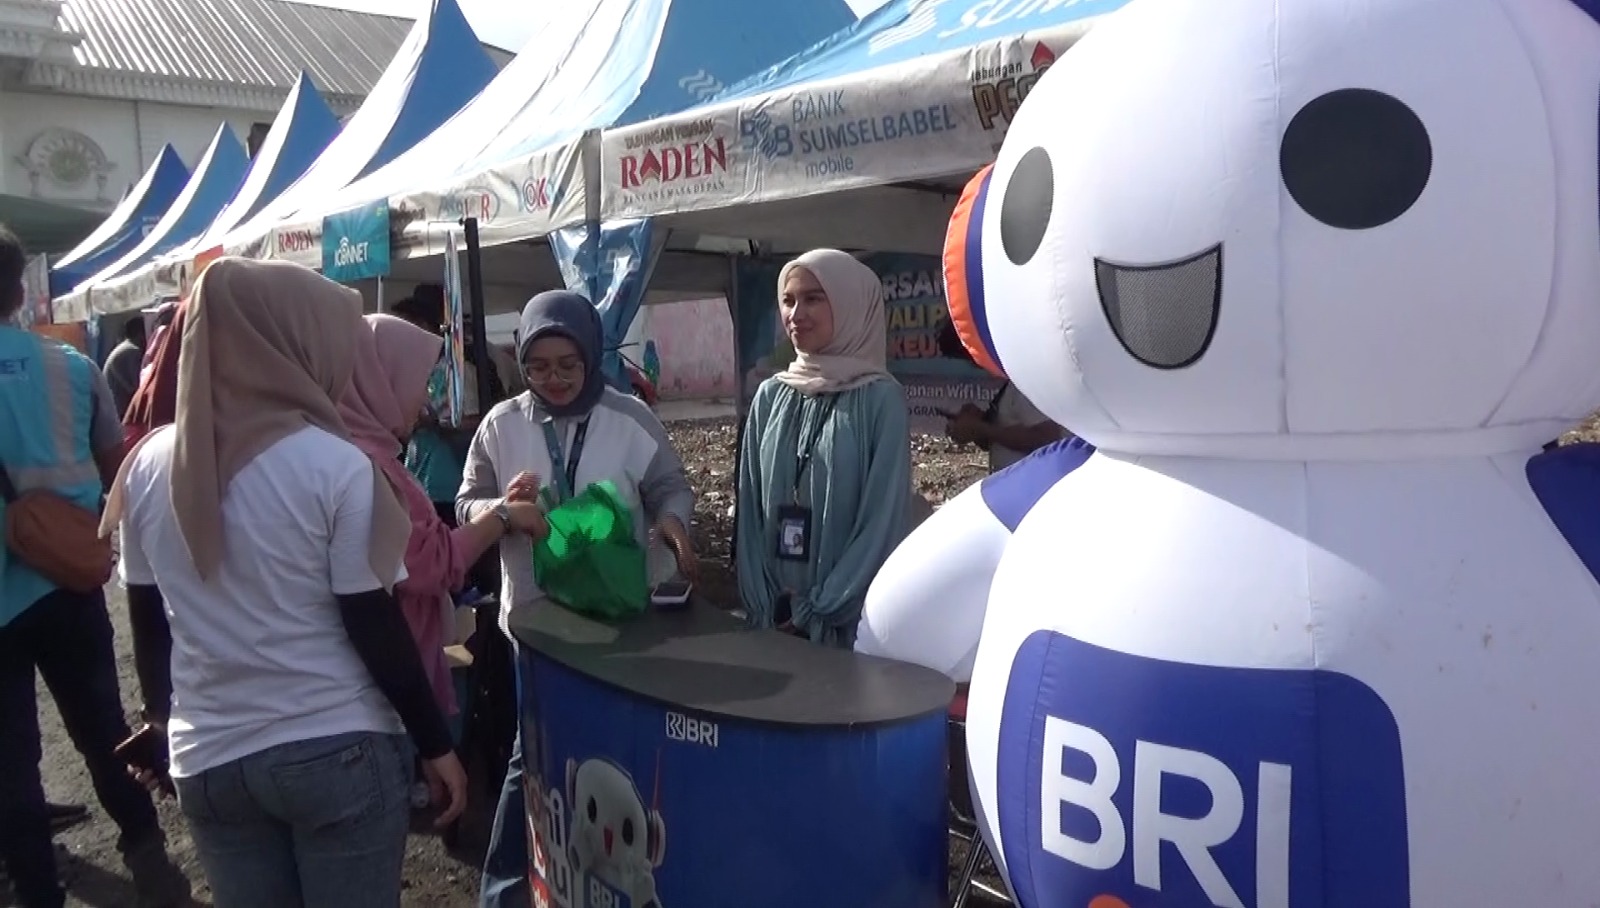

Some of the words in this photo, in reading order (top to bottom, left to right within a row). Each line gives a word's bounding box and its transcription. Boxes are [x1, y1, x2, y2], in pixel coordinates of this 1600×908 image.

[792, 90, 846, 123] BANK
[799, 103, 957, 154] SUMSELBABEL
[619, 136, 727, 190] RADEN
[804, 155, 854, 178] mobile
[278, 229, 314, 253] RADEN
[946, 384, 973, 399] Wifi
[687, 717, 719, 748] BRI
[1041, 714, 1292, 908] BRI
